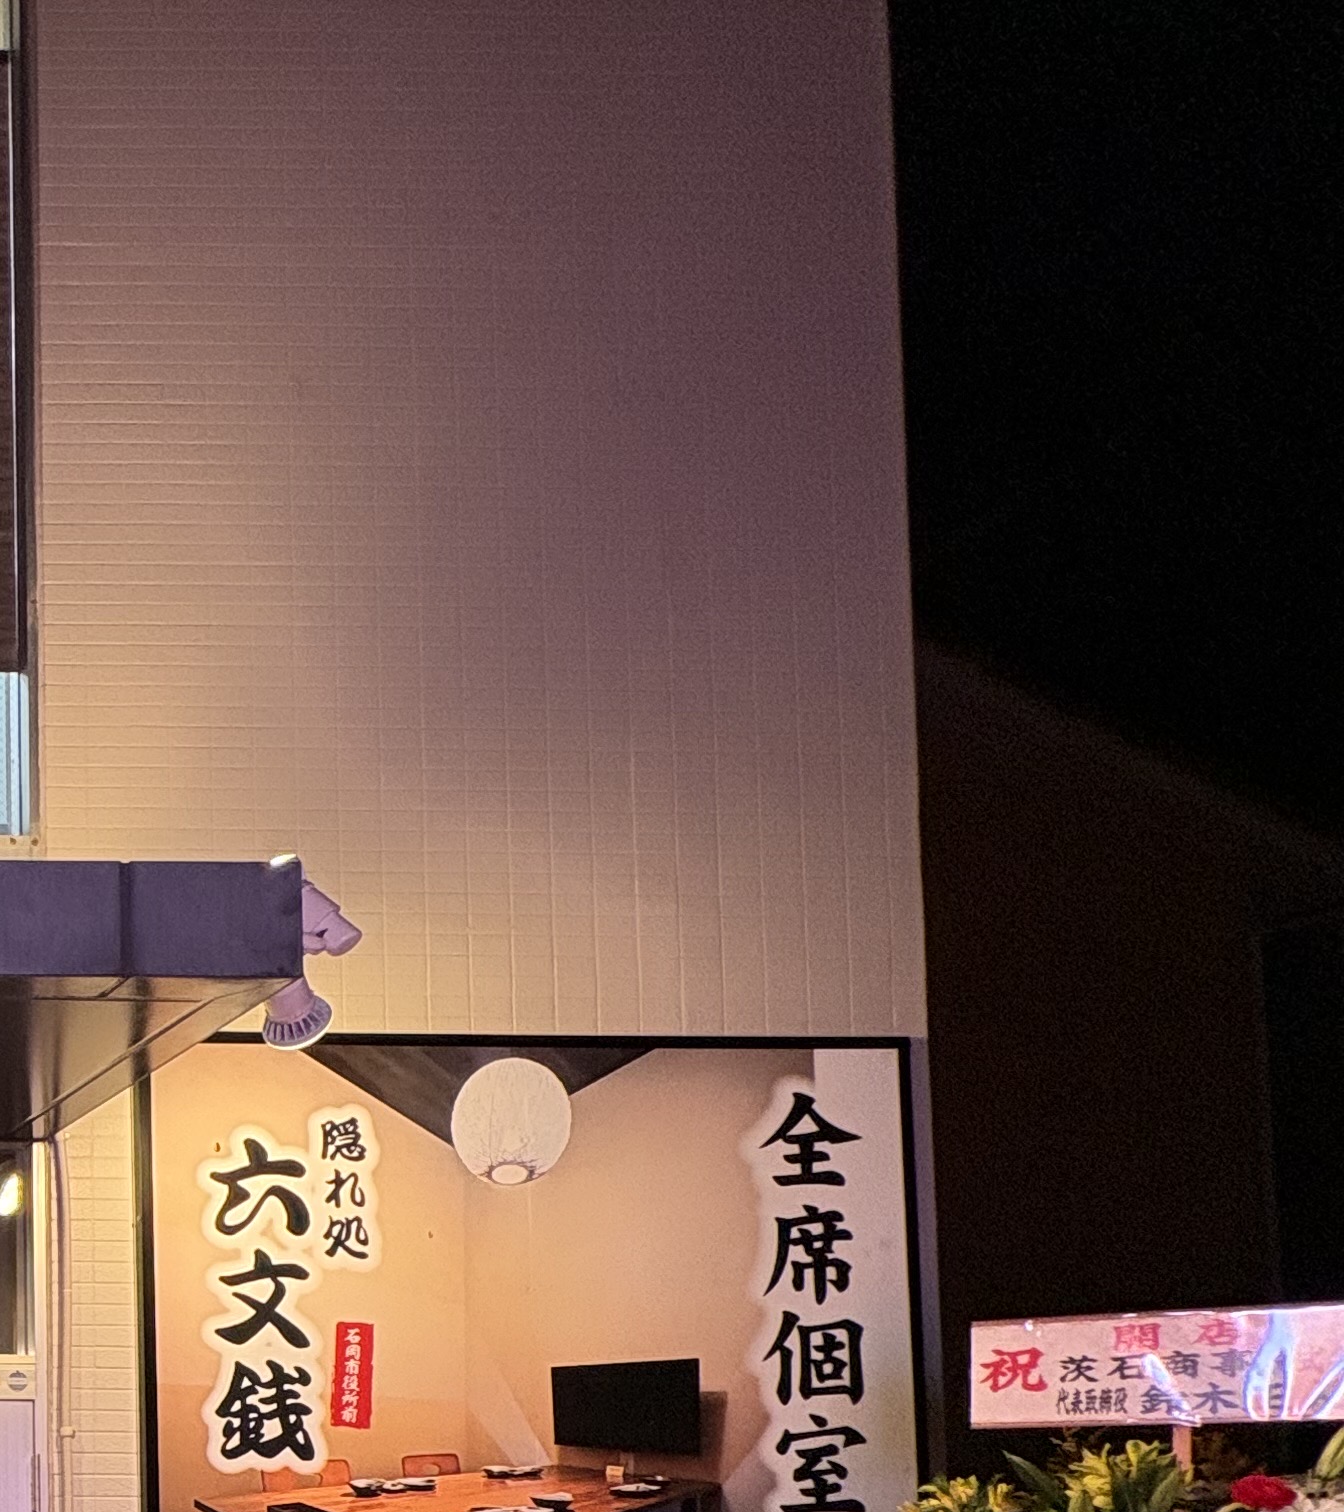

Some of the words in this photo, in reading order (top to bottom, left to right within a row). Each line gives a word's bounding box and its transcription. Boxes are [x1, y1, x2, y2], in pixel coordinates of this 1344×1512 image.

[320, 1117, 370, 1260] 隠れ処
[209, 1137, 316, 1462] 六文銭
[340, 1328, 361, 1423] 石岡市役所前
[980, 1347, 1049, 1393] 祝
